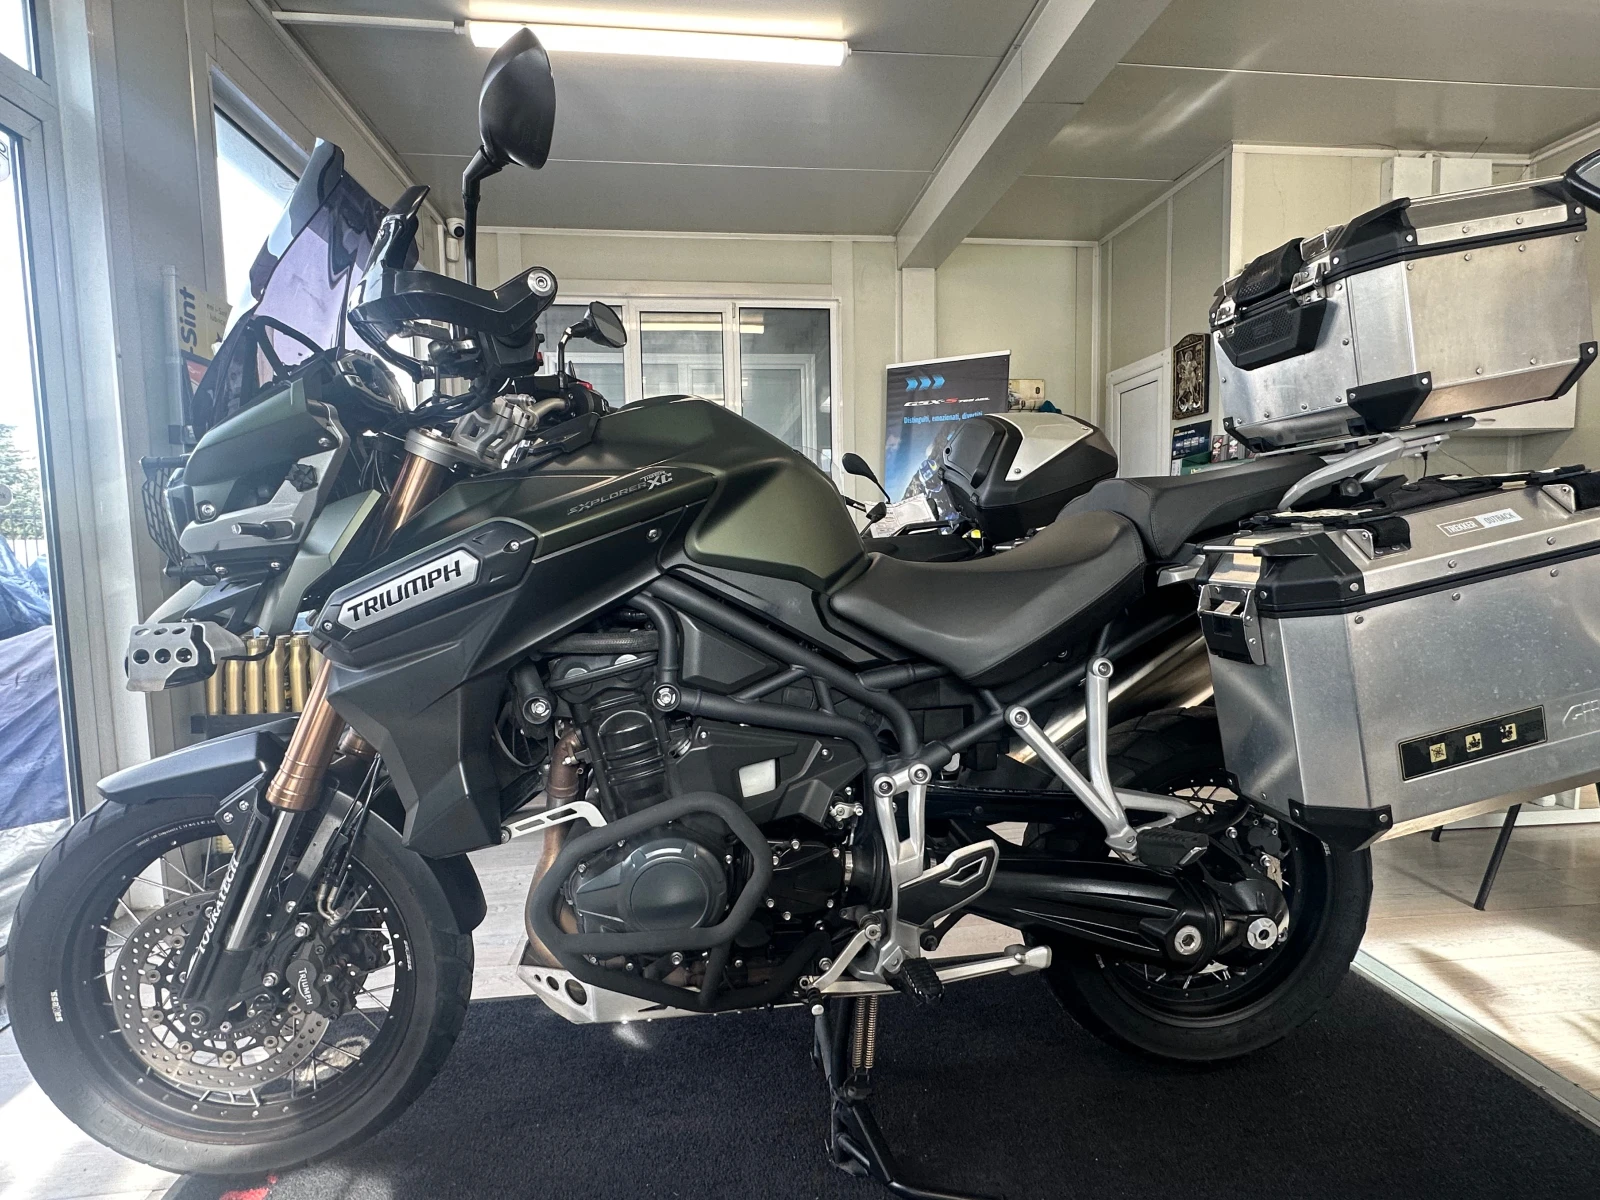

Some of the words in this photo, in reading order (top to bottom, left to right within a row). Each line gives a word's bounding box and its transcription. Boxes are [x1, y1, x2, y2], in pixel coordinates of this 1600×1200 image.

[567, 481, 647, 516] EXPLORER
[646, 472, 673, 491] XC
[1443, 520, 1479, 533] TREKKER
[1483, 512, 1517, 525] OUTBACK
[347, 559, 462, 622] TRIUMPH
[199, 857, 240, 954] TOURATECH
[298, 967, 313, 1005] TRIUMPH
